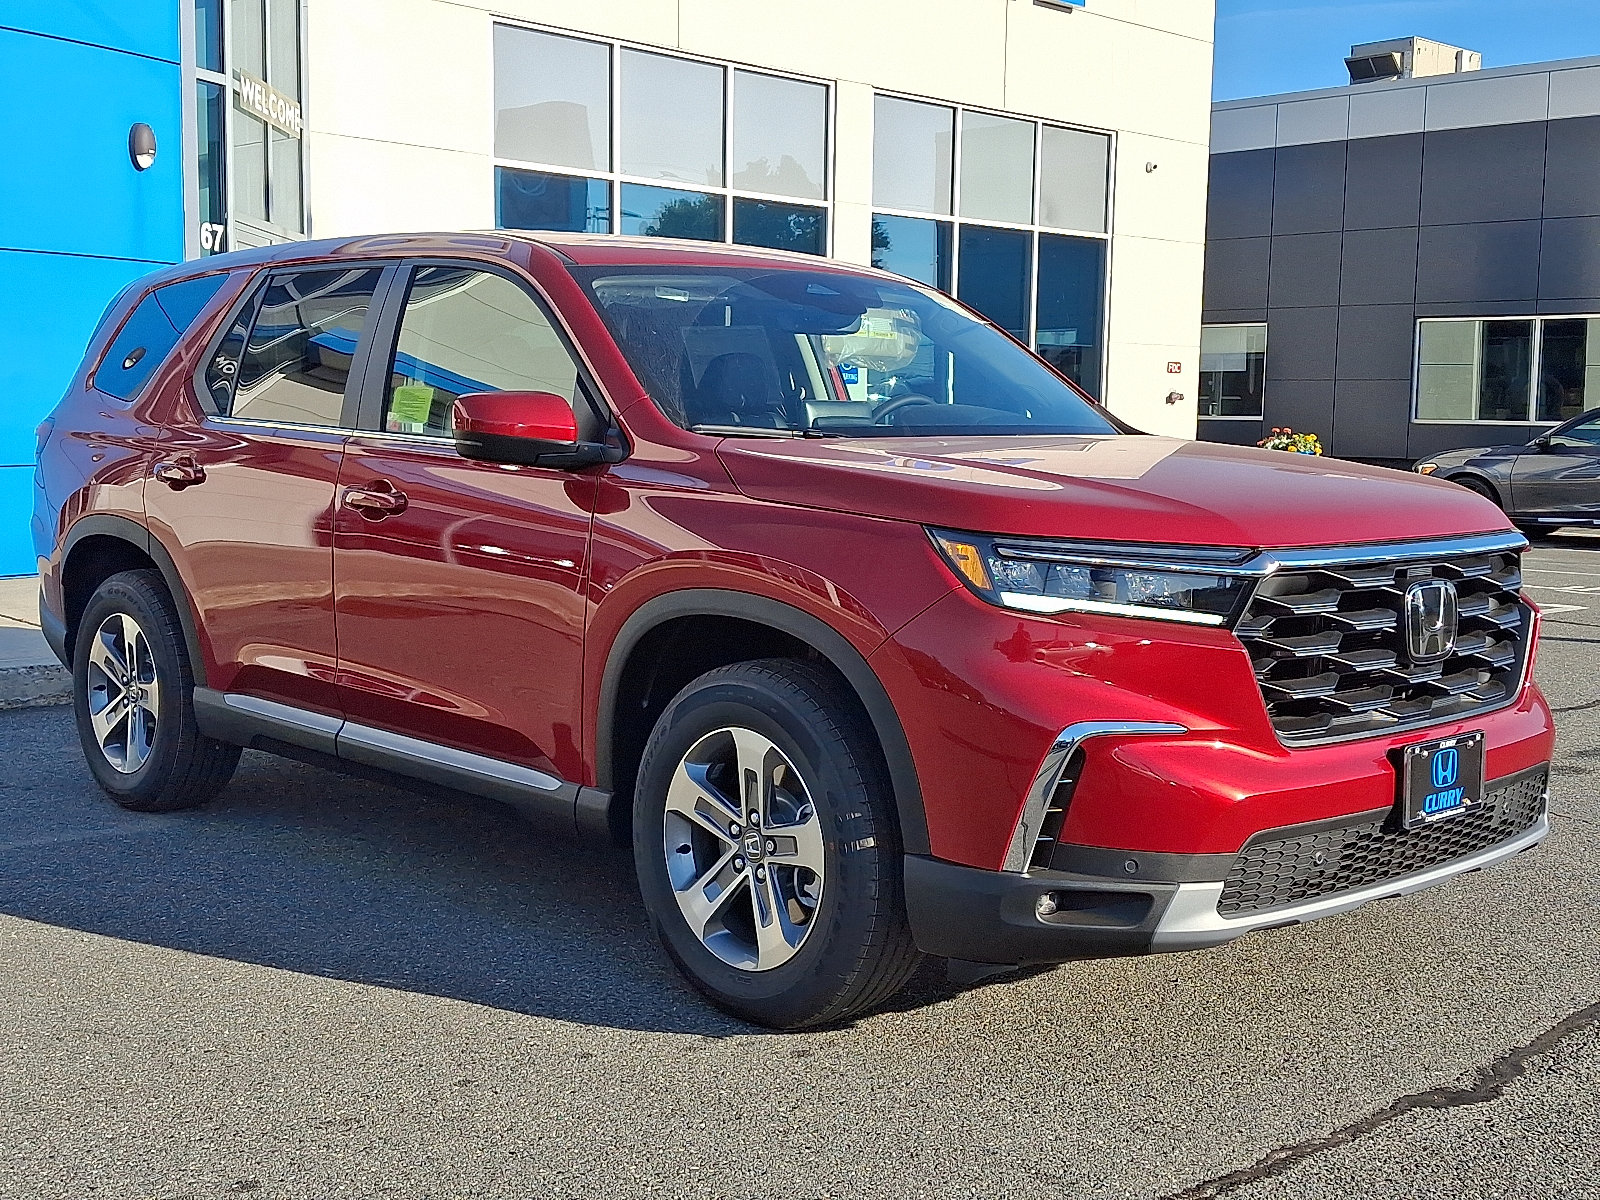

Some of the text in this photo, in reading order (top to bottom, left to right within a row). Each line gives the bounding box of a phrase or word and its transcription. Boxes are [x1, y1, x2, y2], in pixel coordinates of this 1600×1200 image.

[240, 74, 300, 132] WELCOME
[200, 222, 224, 251] 67
[1424, 786, 1464, 813] CURRY
